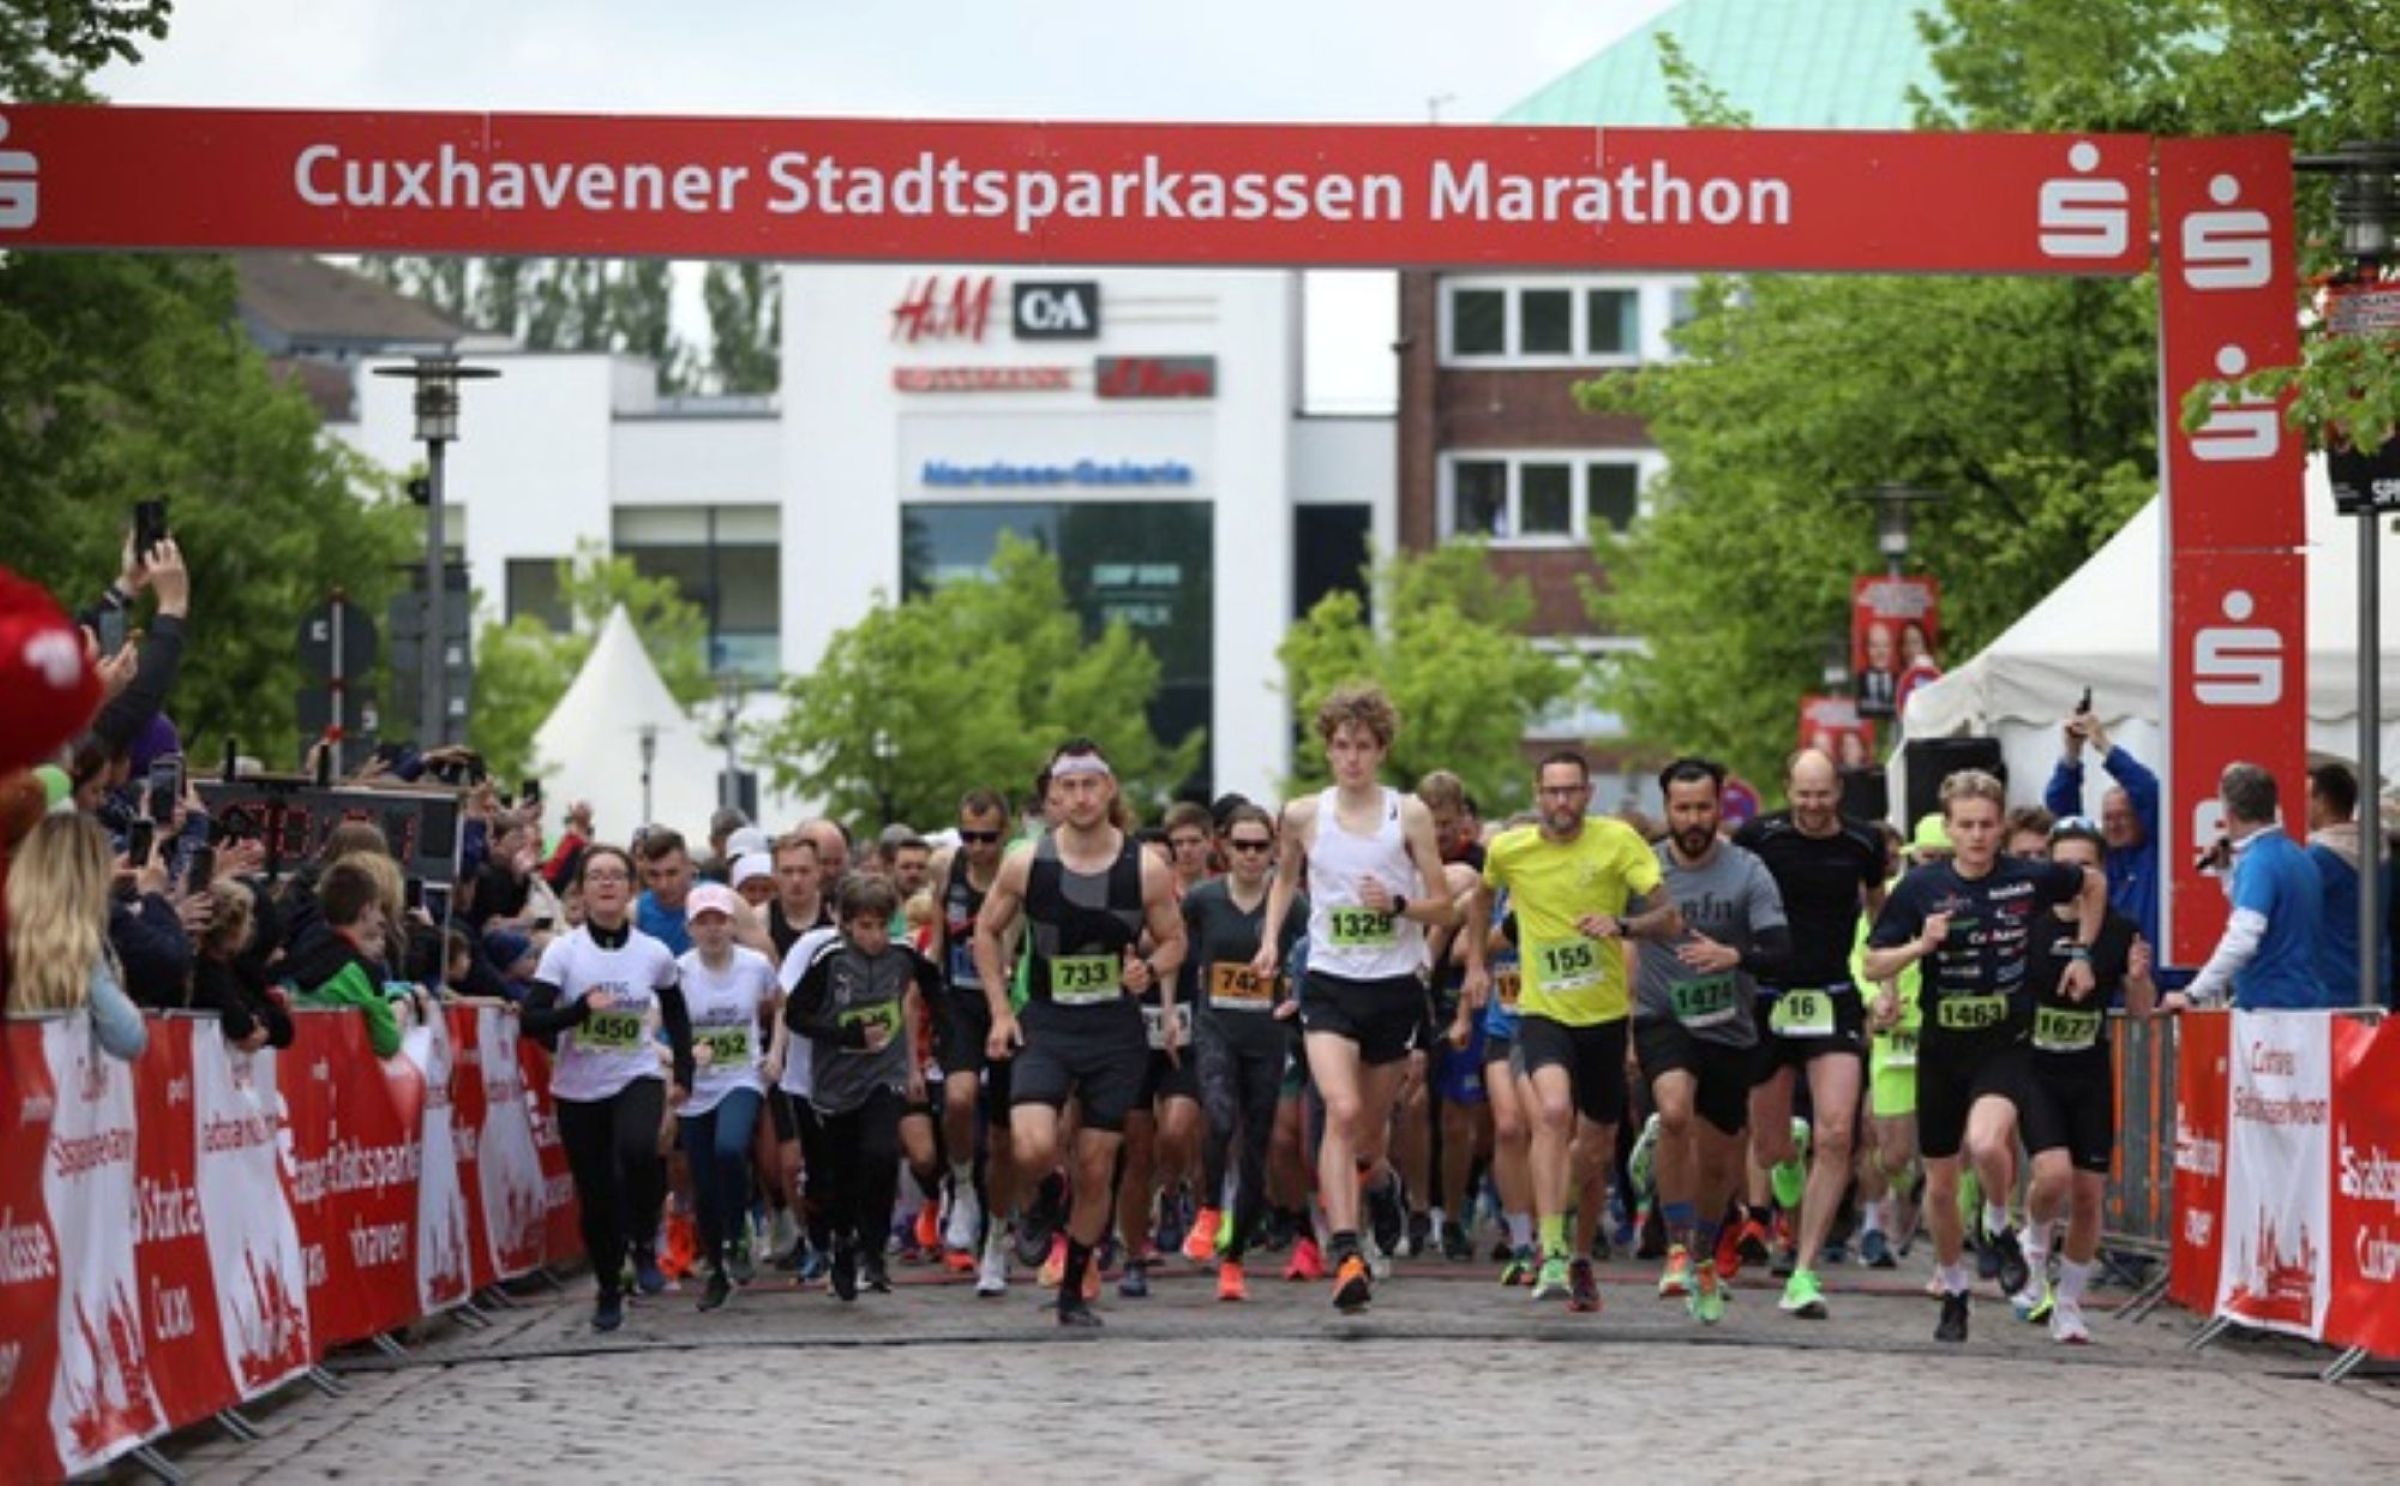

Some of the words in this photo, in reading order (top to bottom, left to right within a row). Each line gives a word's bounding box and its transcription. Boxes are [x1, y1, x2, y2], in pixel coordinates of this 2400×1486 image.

[294, 144, 748, 212] Cuxhavener
[767, 151, 1403, 232] Stadtsparkassen
[1429, 159, 1791, 226] Marathon
[1332, 911, 1392, 938] 1329
[1546, 944, 1593, 972] 155
[1060, 963, 1109, 987] 733
[1789, 996, 1815, 1017] 16
[581, 1017, 641, 1041] 1450
